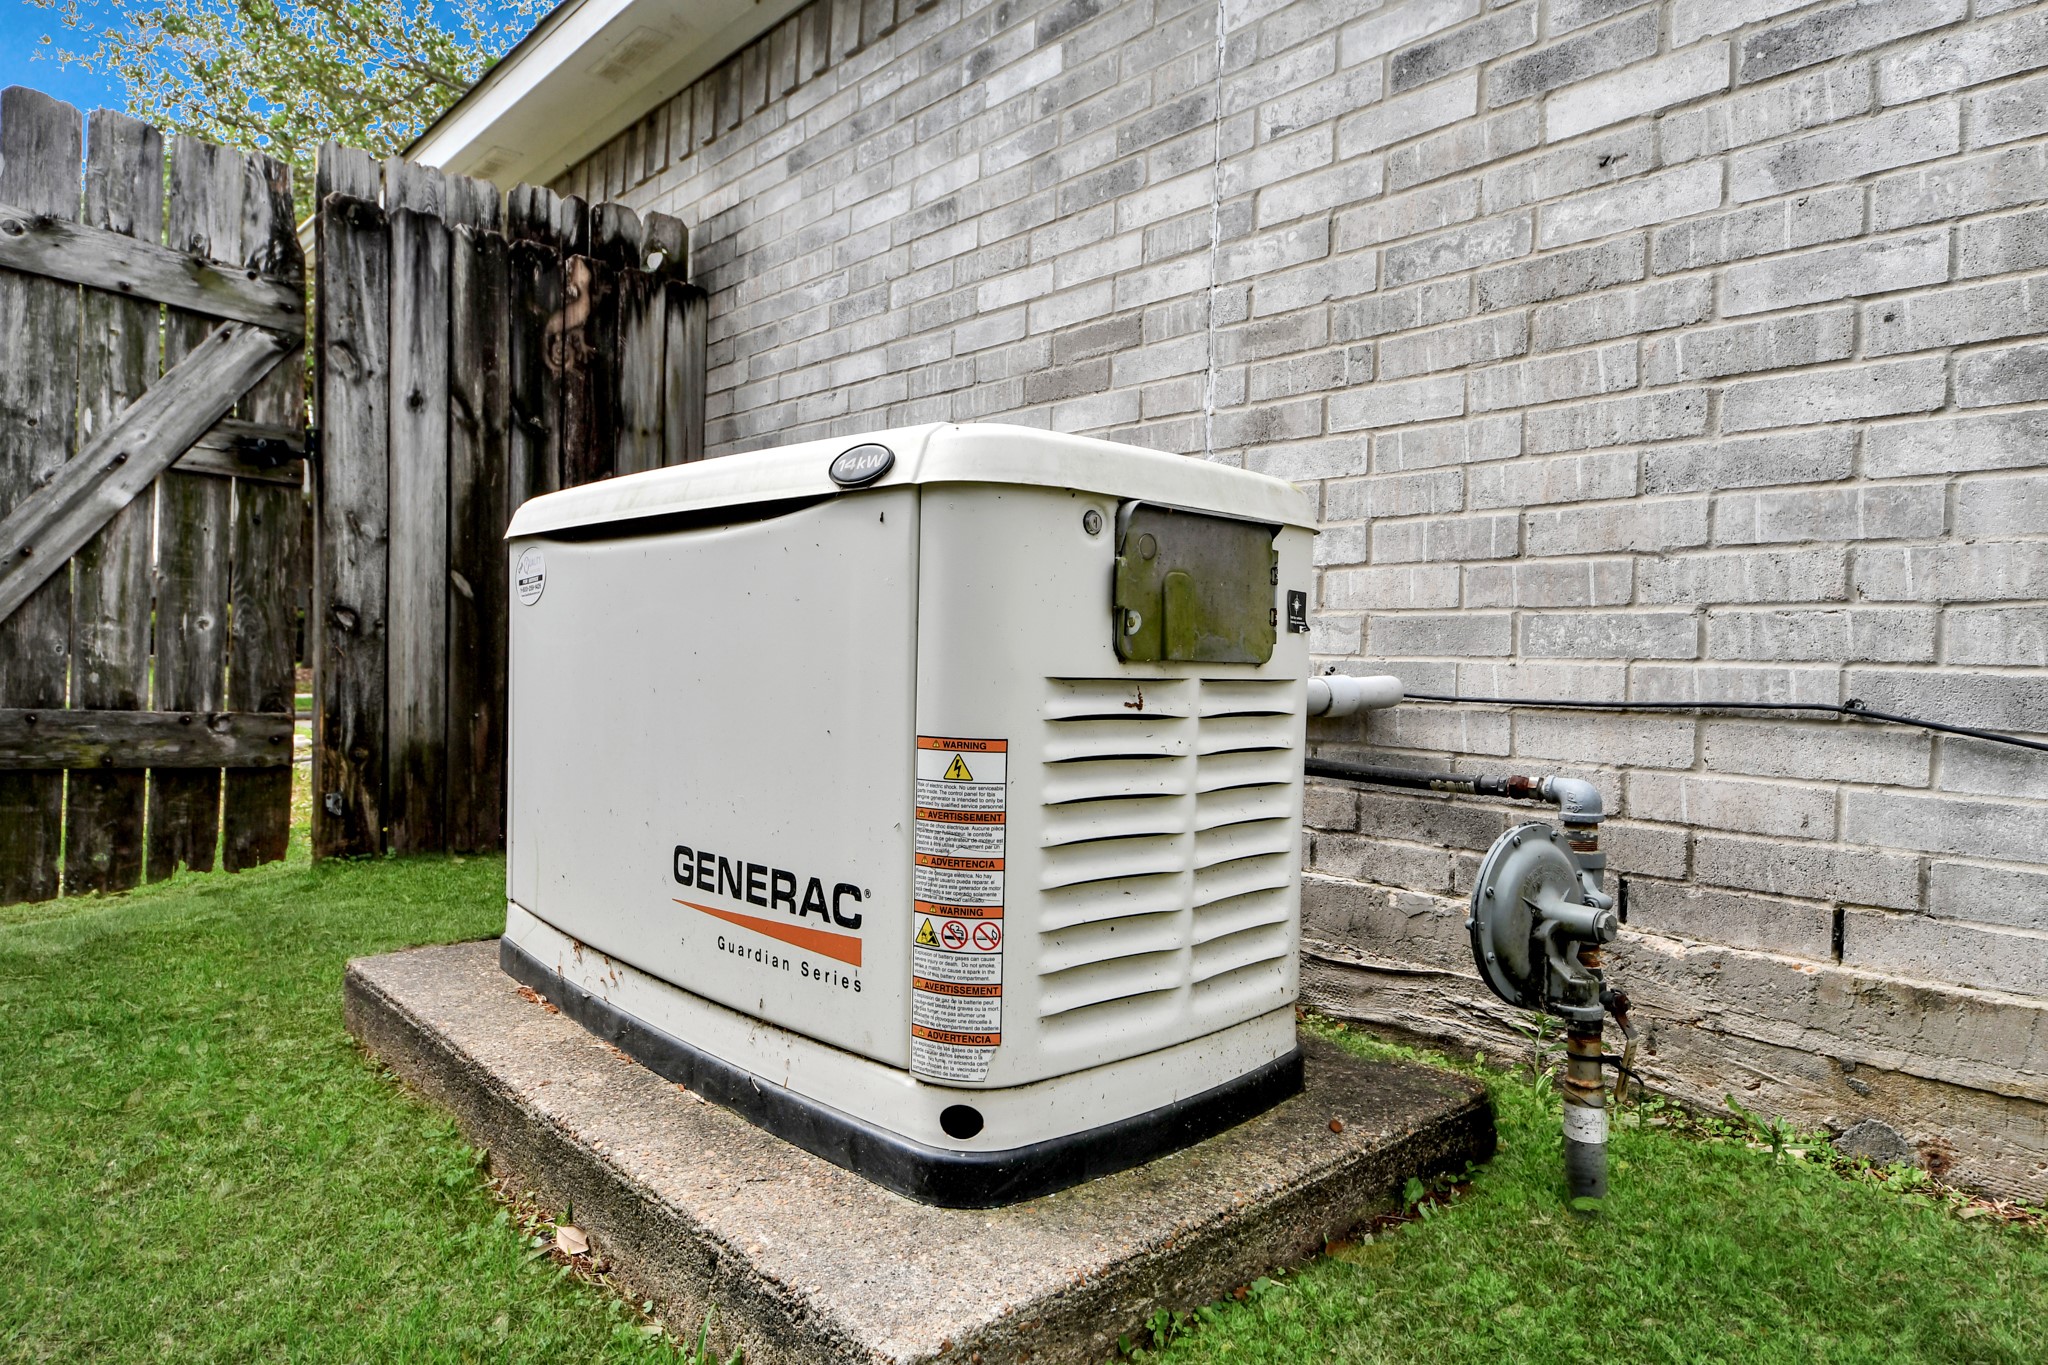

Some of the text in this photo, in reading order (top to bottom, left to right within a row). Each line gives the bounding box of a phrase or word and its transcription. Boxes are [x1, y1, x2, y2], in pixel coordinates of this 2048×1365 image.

[839, 453, 885, 471] 14kW
[943, 741, 986, 749] WARNING
[928, 811, 1002, 821] AVERTISSEMENT
[931, 858, 995, 869] ADVERTENCIA
[940, 906, 983, 916] WARNING
[718, 936, 861, 992] Guardian Series
[925, 982, 998, 995] AVERTISSEMENT
[928, 1031, 991, 1043] ADVERTENCIA
